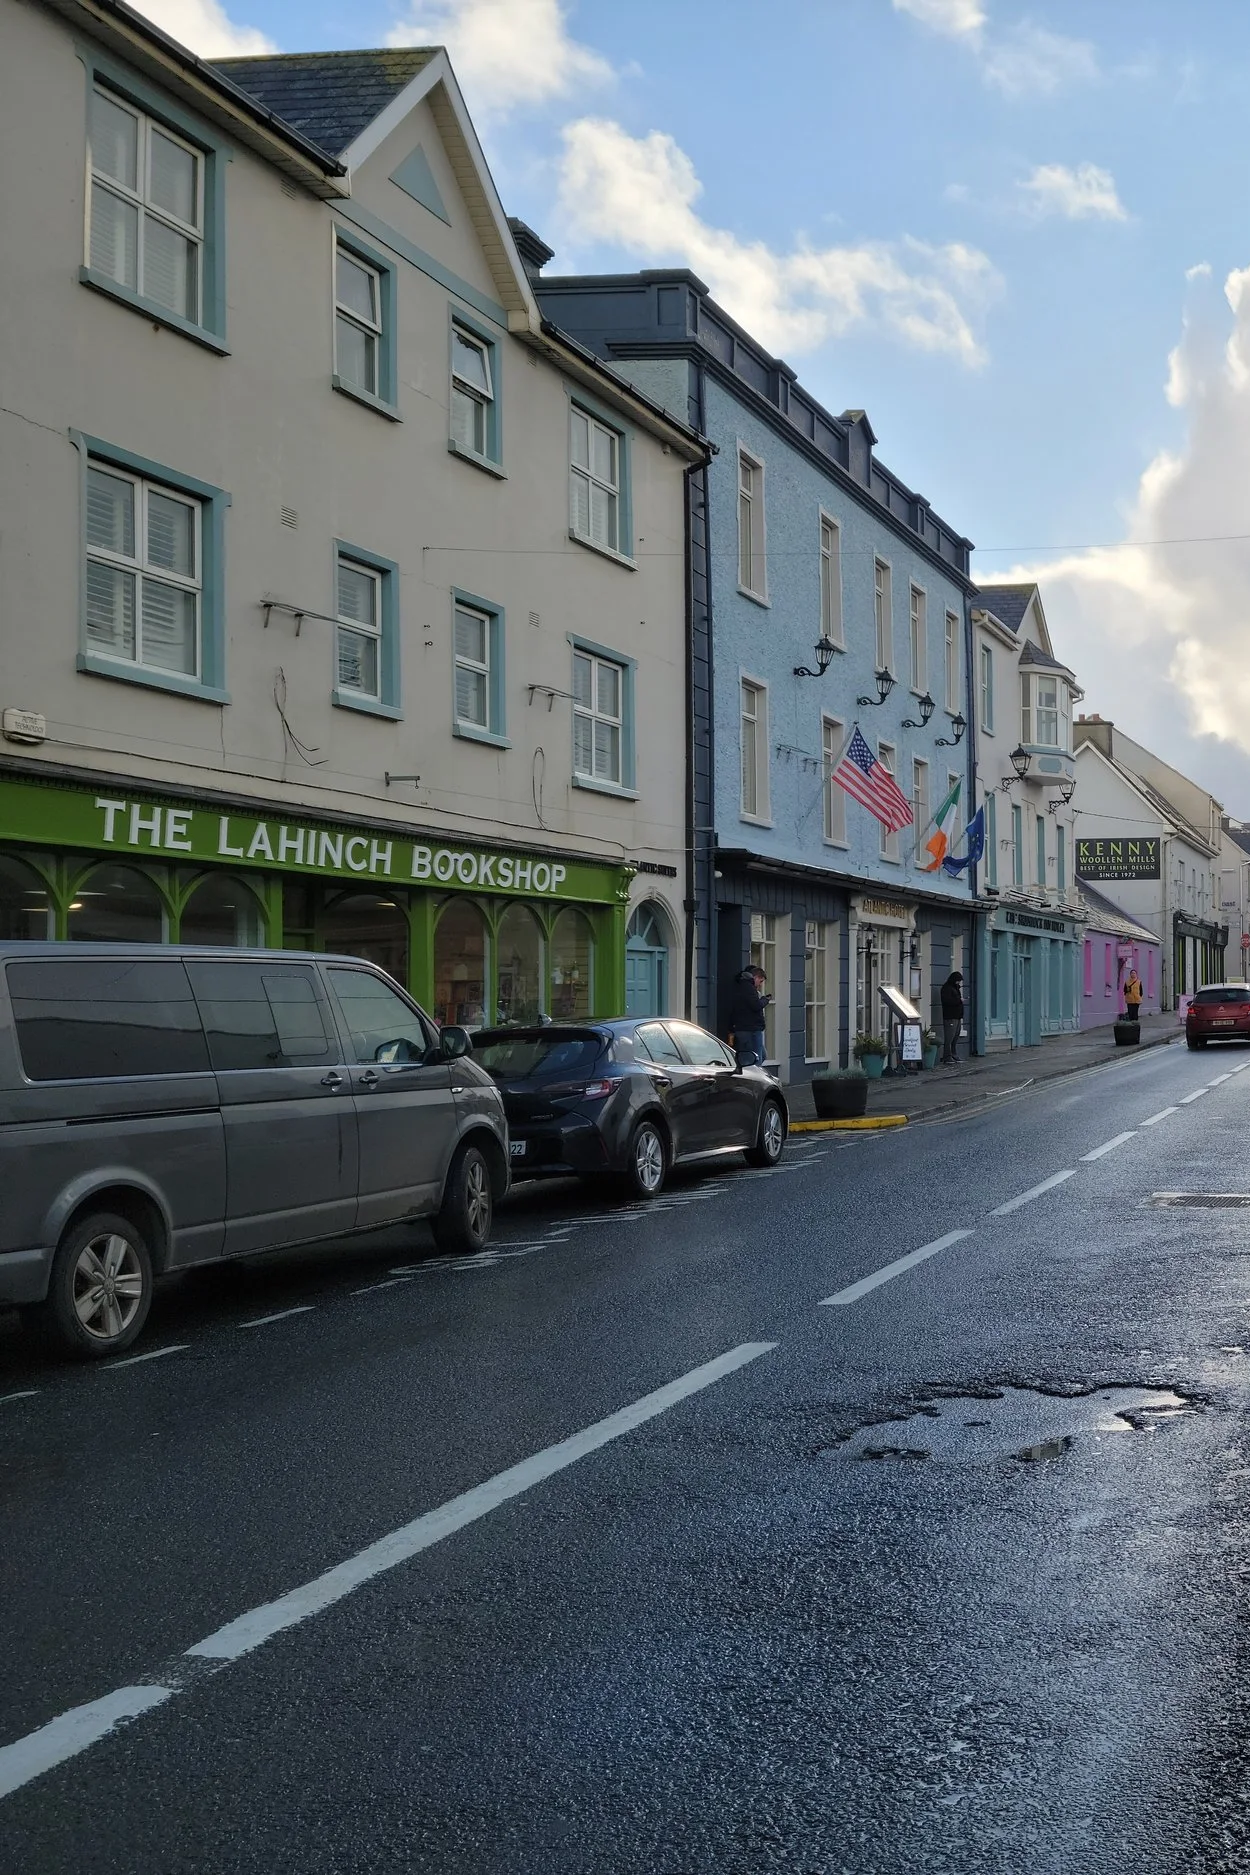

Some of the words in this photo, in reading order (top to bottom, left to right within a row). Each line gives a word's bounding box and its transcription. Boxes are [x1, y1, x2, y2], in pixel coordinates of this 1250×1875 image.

[95, 797, 193, 851] THE
[217, 816, 393, 875] LAHINCH
[411, 845, 566, 892] BOOKSHOP
[1079, 841, 1156, 856] KENNY
[1080, 856, 1123, 864] WOOLLEN
[1128, 855, 1156, 863] MILLS
